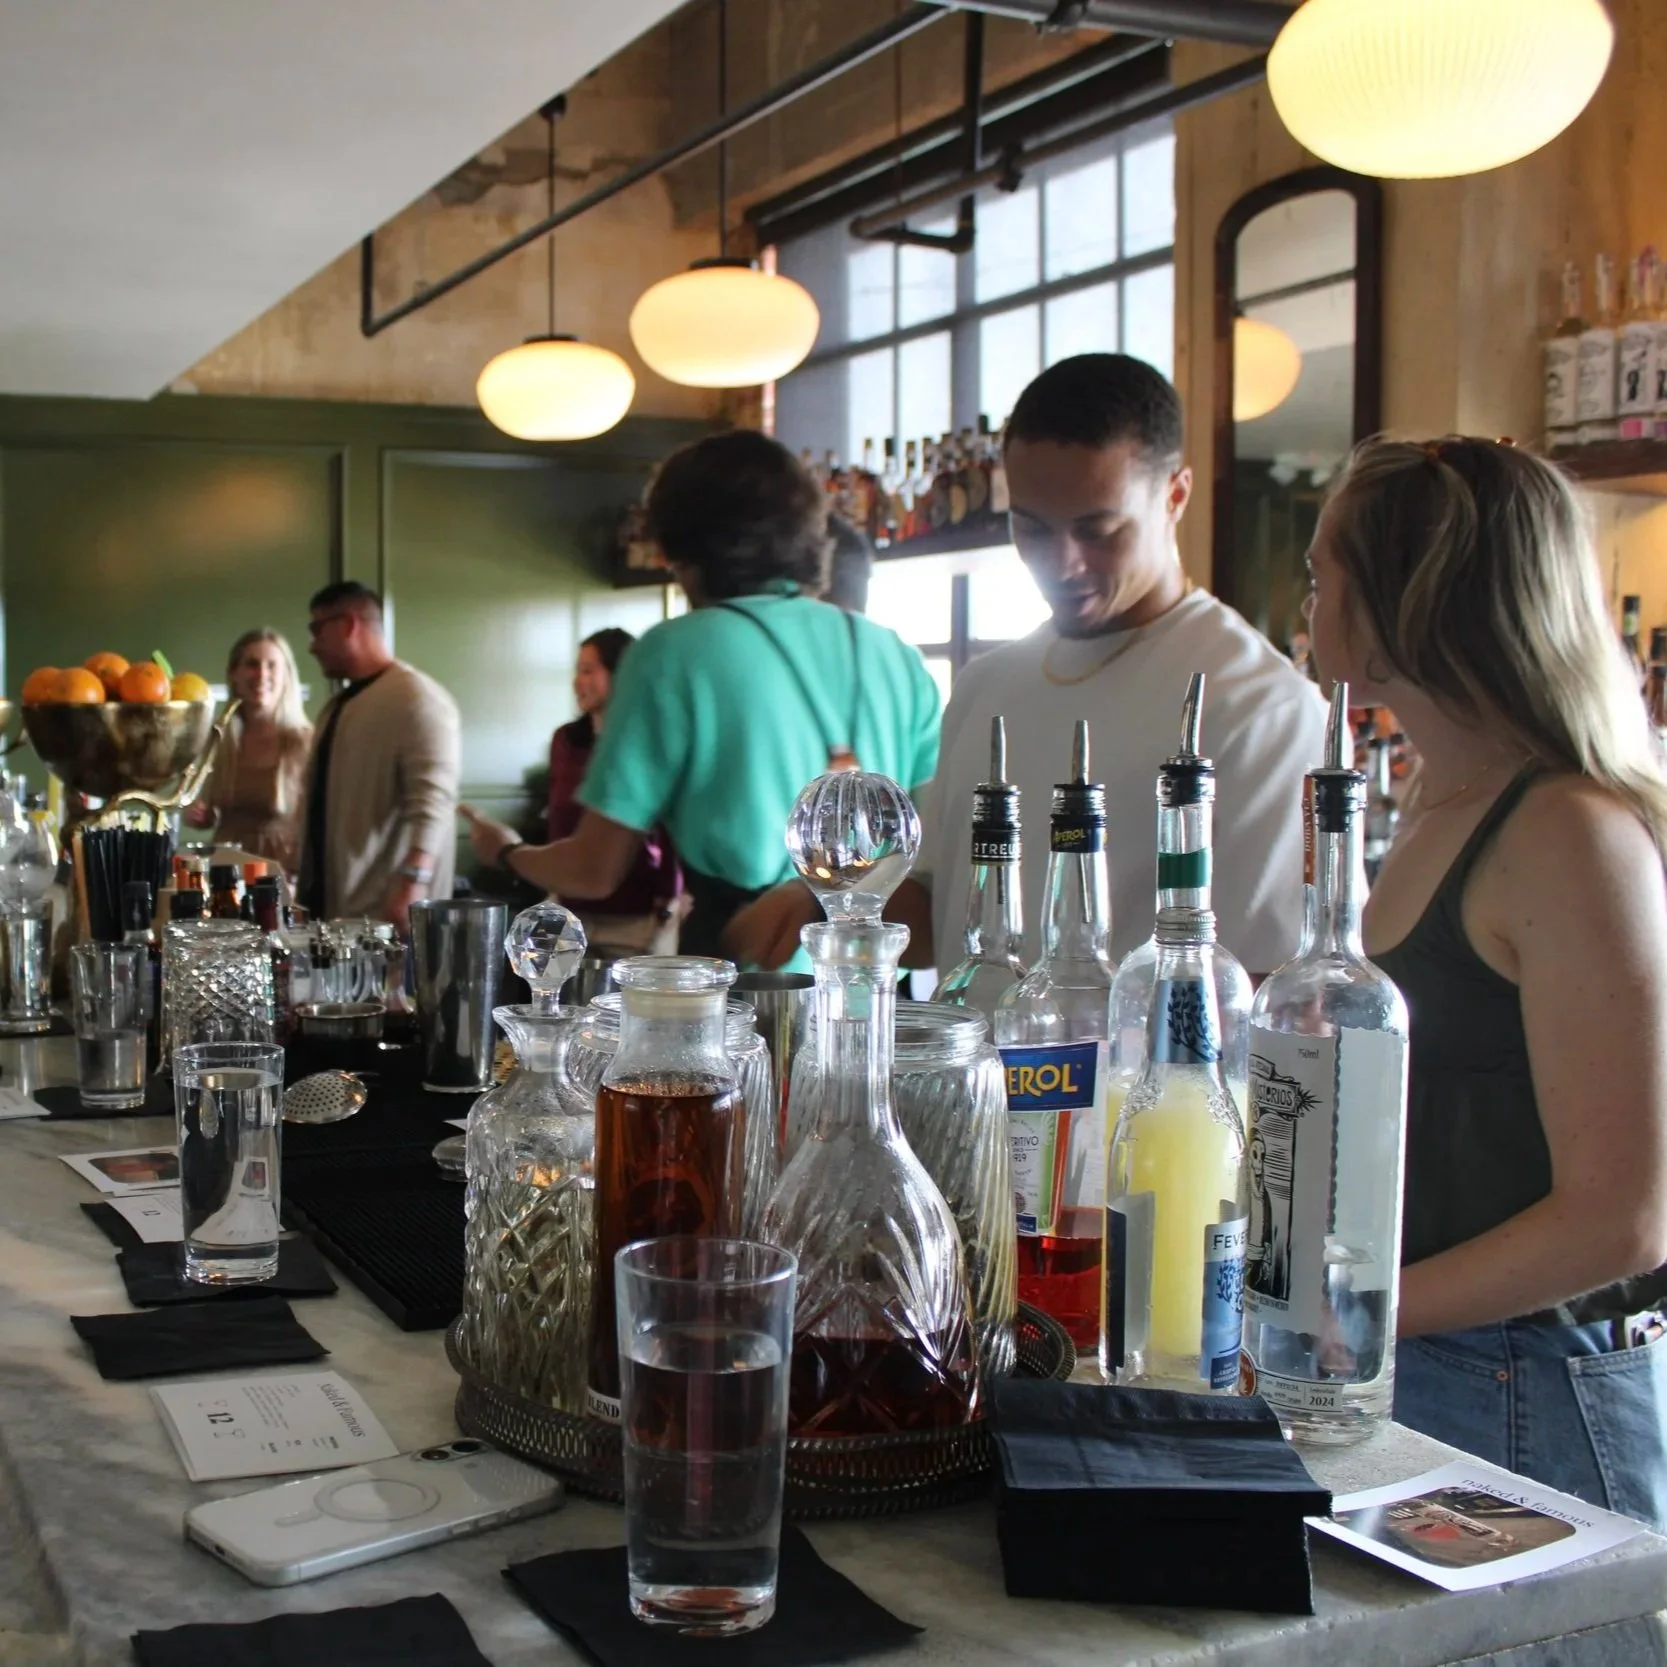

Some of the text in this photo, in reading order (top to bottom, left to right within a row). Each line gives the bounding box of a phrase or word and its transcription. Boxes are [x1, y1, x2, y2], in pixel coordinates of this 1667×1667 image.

[1004, 1063, 1079, 1097] EROL
[1308, 1396, 1335, 1407] 2024
[206, 1412, 235, 1425] 12
[1461, 1479, 1514, 1500] naked
[1529, 1502, 1595, 1528] famous
